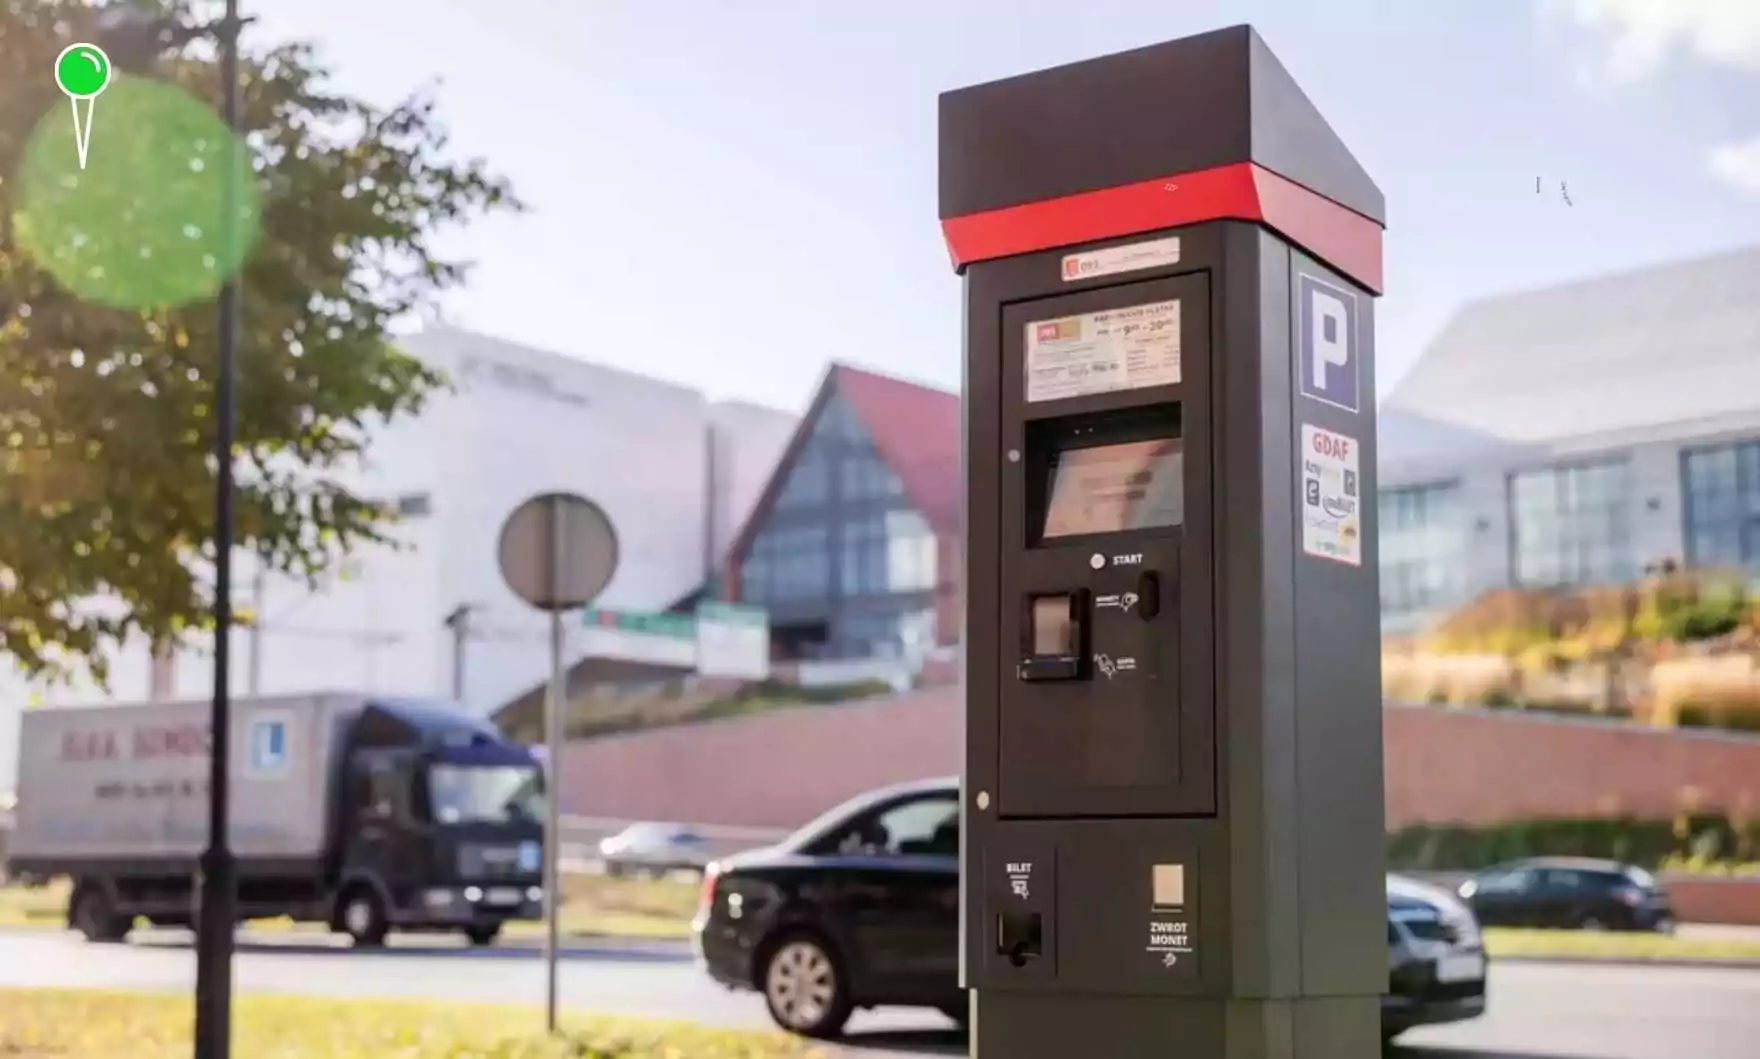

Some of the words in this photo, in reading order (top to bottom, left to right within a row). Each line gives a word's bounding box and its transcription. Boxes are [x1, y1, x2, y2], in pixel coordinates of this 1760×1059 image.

[1312, 289, 1348, 390] P
[1312, 432, 1349, 462] GDAF
[1112, 553, 1143, 566] START
[1006, 863, 1032, 873] BILET
[1150, 922, 1187, 933] ZWROT
[1150, 934, 1187, 945] MONET
